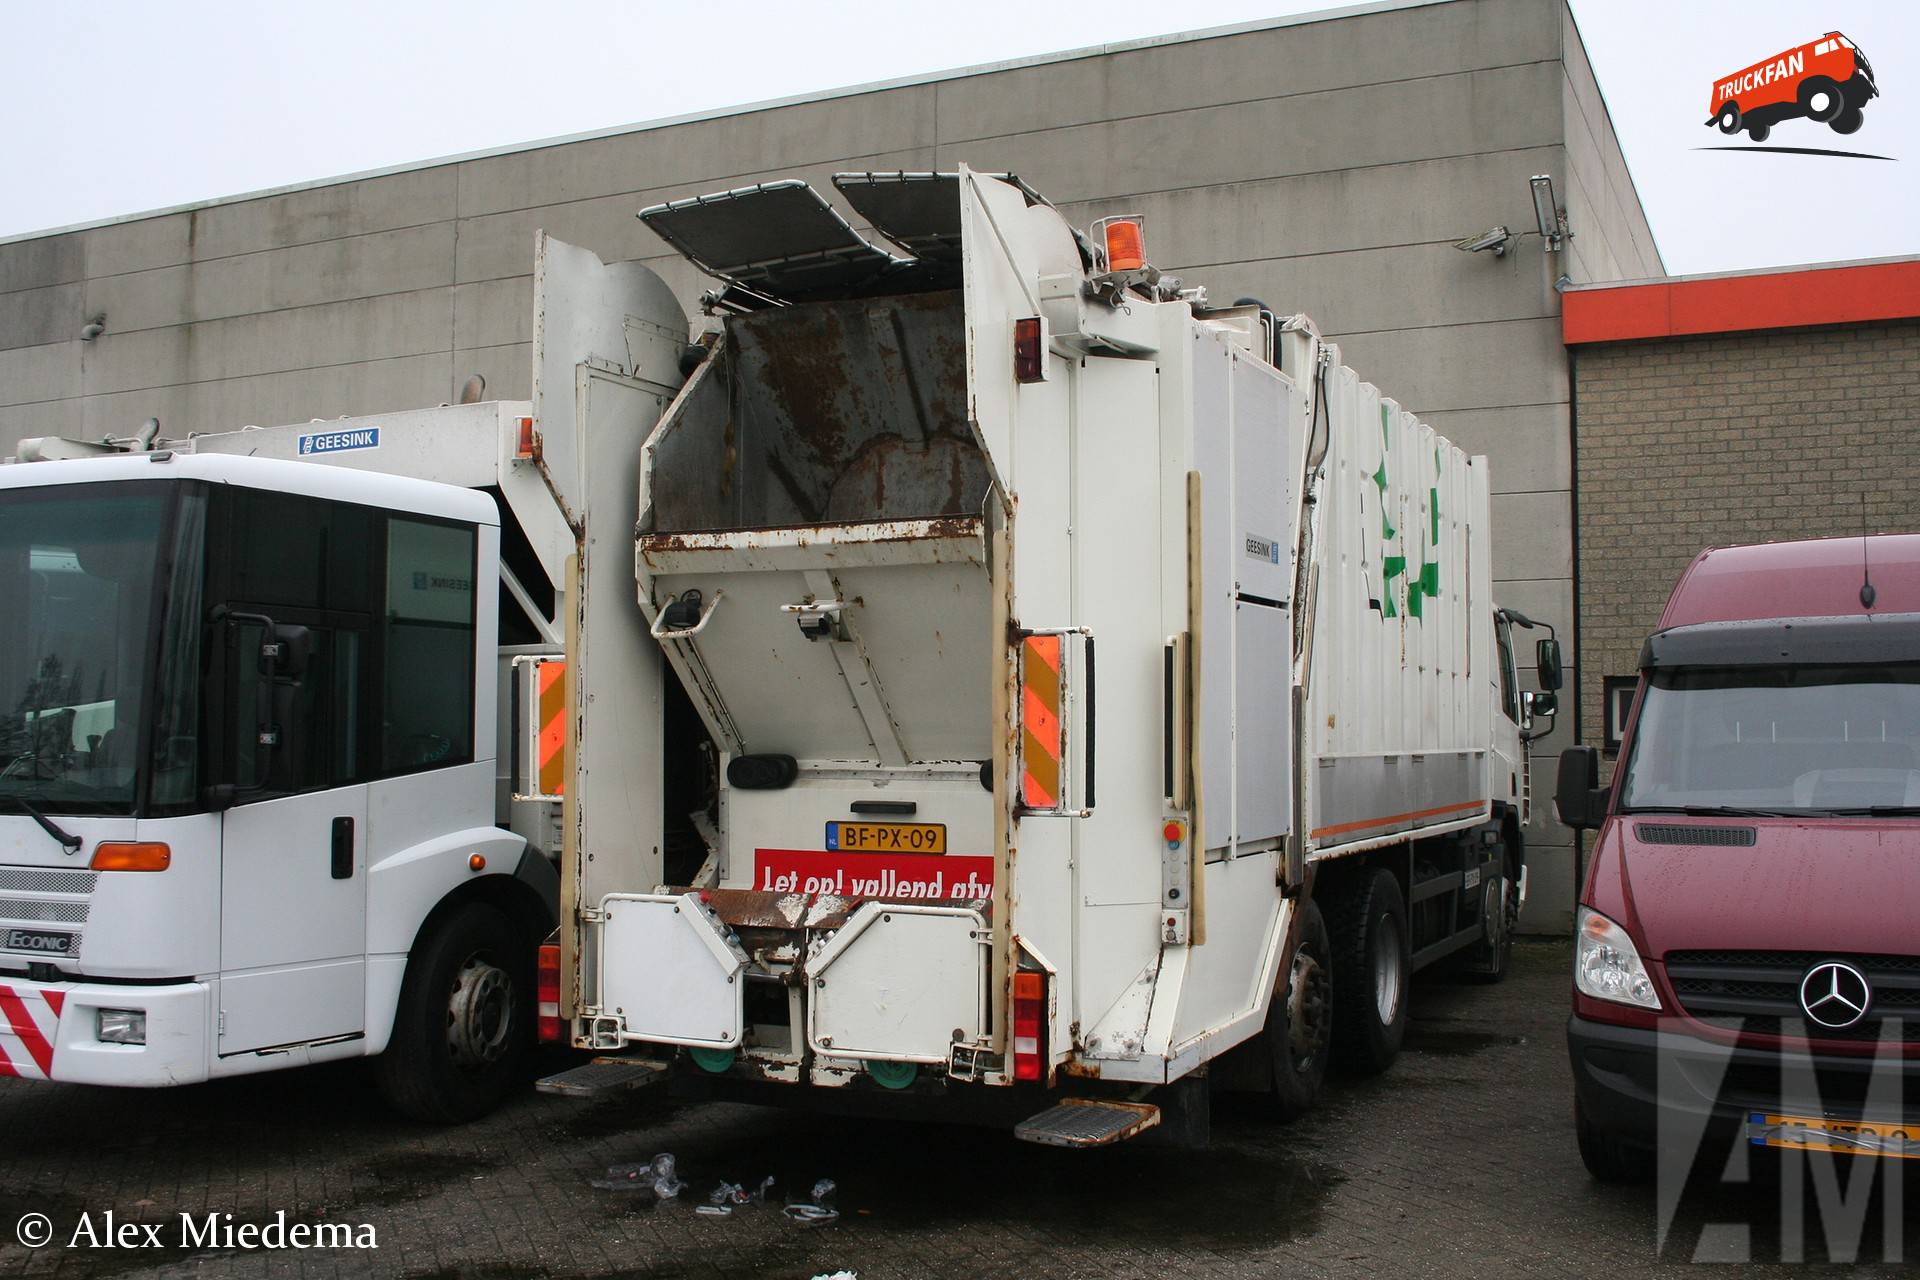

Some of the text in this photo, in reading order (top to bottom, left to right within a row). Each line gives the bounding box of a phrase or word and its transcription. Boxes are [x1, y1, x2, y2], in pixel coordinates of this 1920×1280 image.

[316, 431, 373, 450] GEESINK
[1246, 538, 1270, 558] GEESINK
[845, 827, 937, 849] BF-PX-09
[762, 866, 994, 899] Let op! vallend afv
